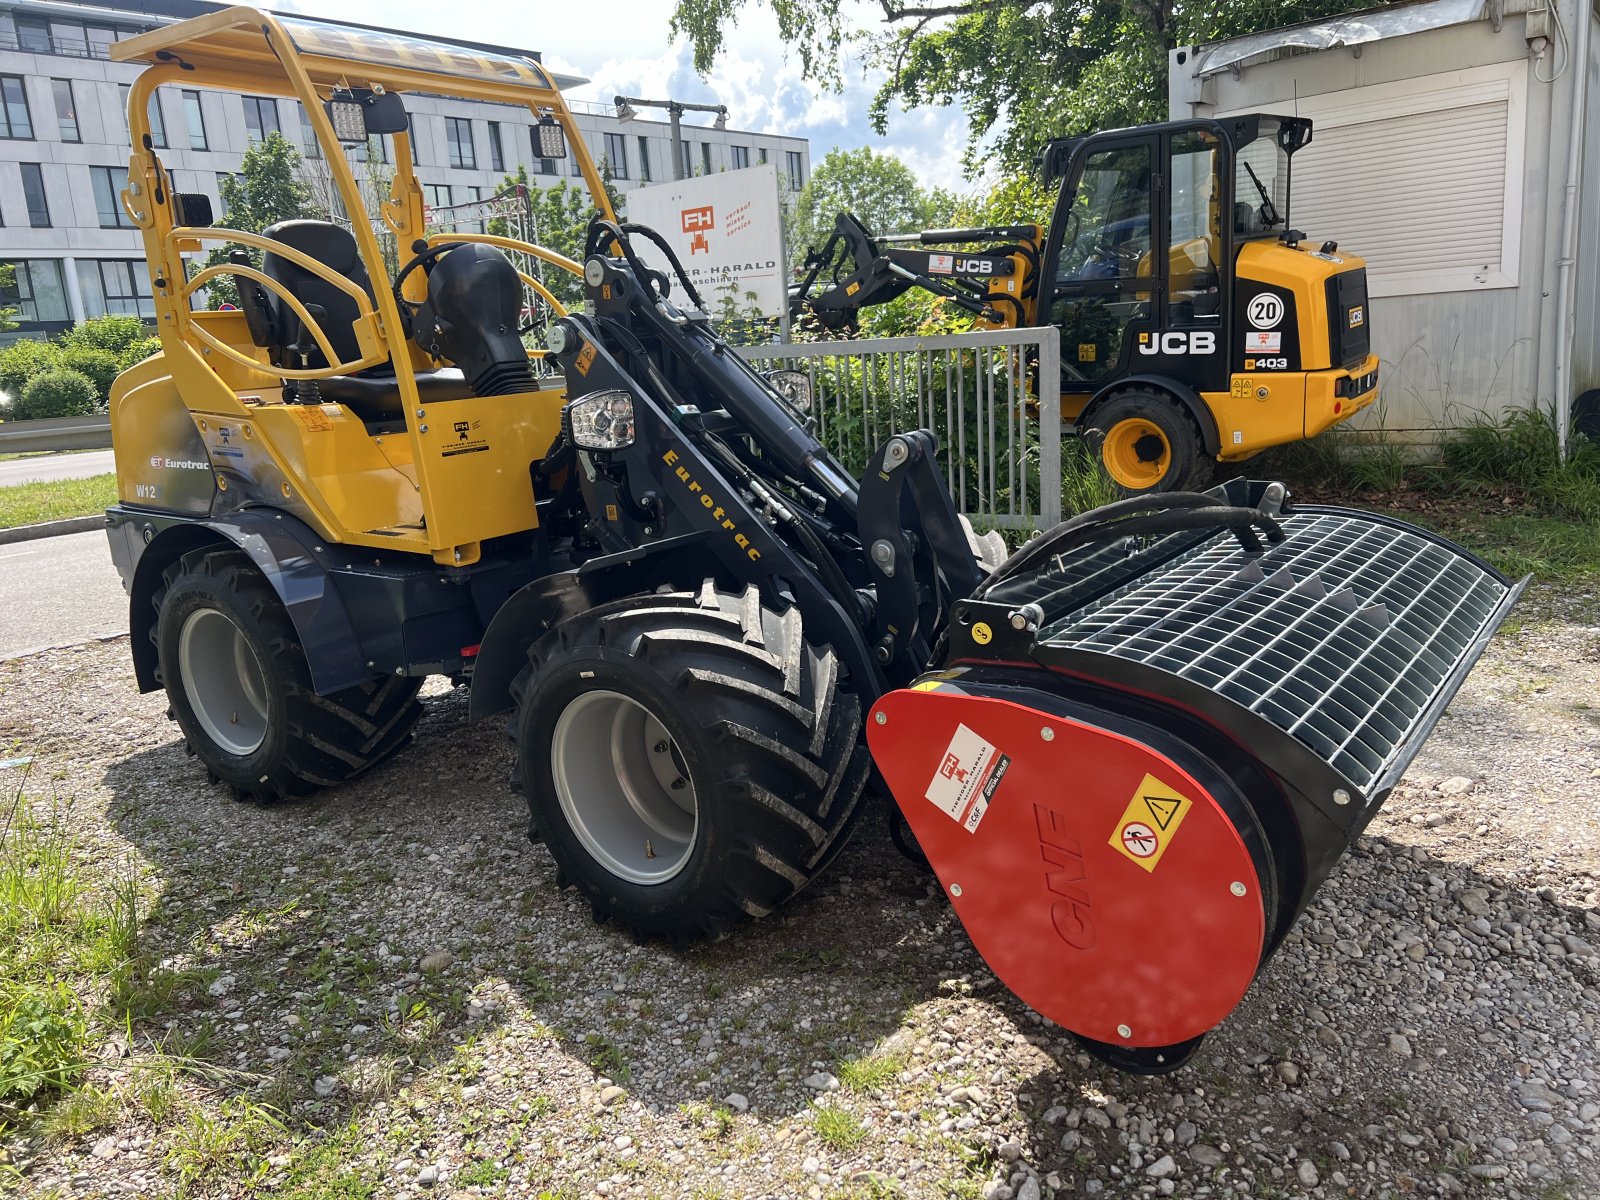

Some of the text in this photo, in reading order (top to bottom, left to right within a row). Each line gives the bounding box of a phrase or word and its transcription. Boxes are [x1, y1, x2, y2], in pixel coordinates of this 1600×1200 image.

[684, 211, 711, 228] FH
[726, 214, 745, 228] miete
[956, 260, 993, 273] JCB
[1255, 302, 1276, 320] 20
[1139, 331, 1216, 355] JCB
[1256, 358, 1287, 368] 403
[165, 458, 209, 470] Eurotrac
[662, 449, 761, 561] Eurotrac
[942, 755, 957, 777] FH
[986, 776, 998, 797] OFFICIAL
[995, 758, 1008, 777] DEALER
[1033, 802, 1096, 951] CNF
